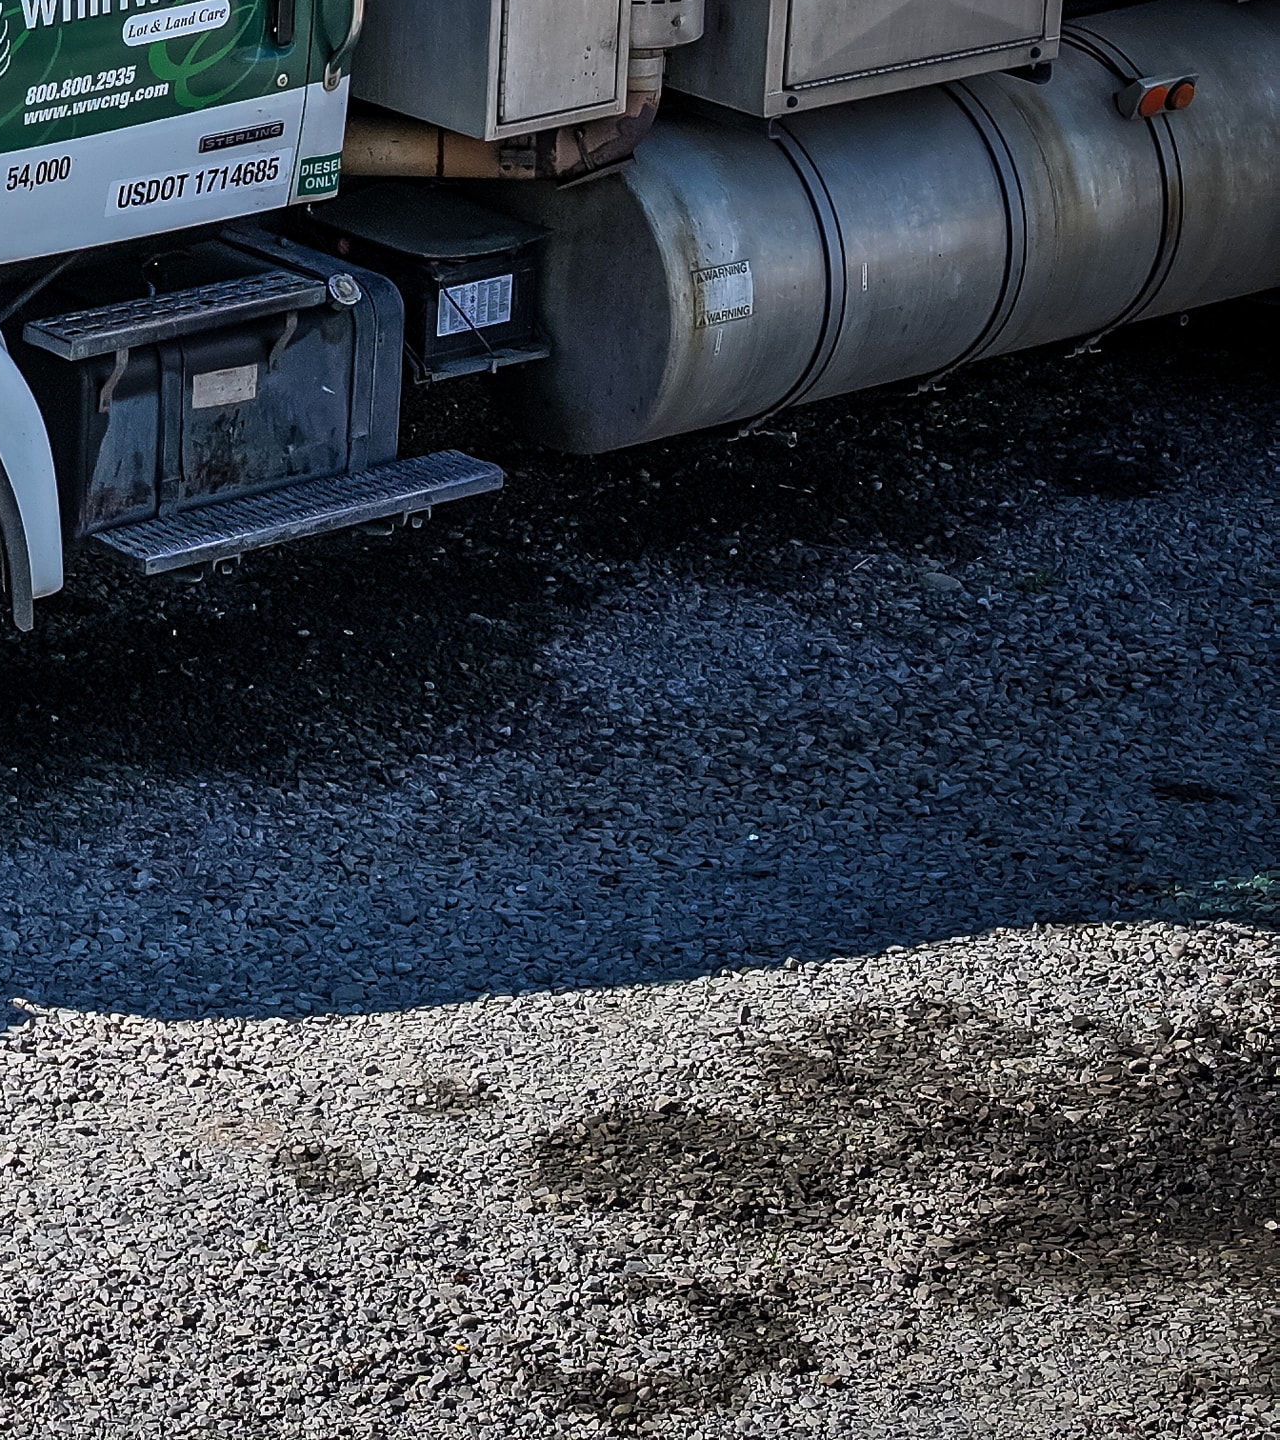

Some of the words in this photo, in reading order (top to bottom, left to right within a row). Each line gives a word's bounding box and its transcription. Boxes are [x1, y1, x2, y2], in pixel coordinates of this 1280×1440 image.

[127, 24, 148, 39] Lot
[150, 19, 162, 34] &
[164, 11, 196, 31] Land
[198, 7, 227, 25] Care
[25, 65, 137, 106] 800.800.2935
[24, 82, 170, 126] www.wwcng.com
[205, 124, 281, 149] STERLING
[301, 158, 342, 177] DIESEL
[6, 156, 72, 191] 54,000
[116, 173, 190, 210] USDOT
[194, 156, 281, 195] 1714685
[305, 173, 338, 190] ONLY
[704, 262, 748, 281] WARNING
[707, 304, 751, 326] WARNING
